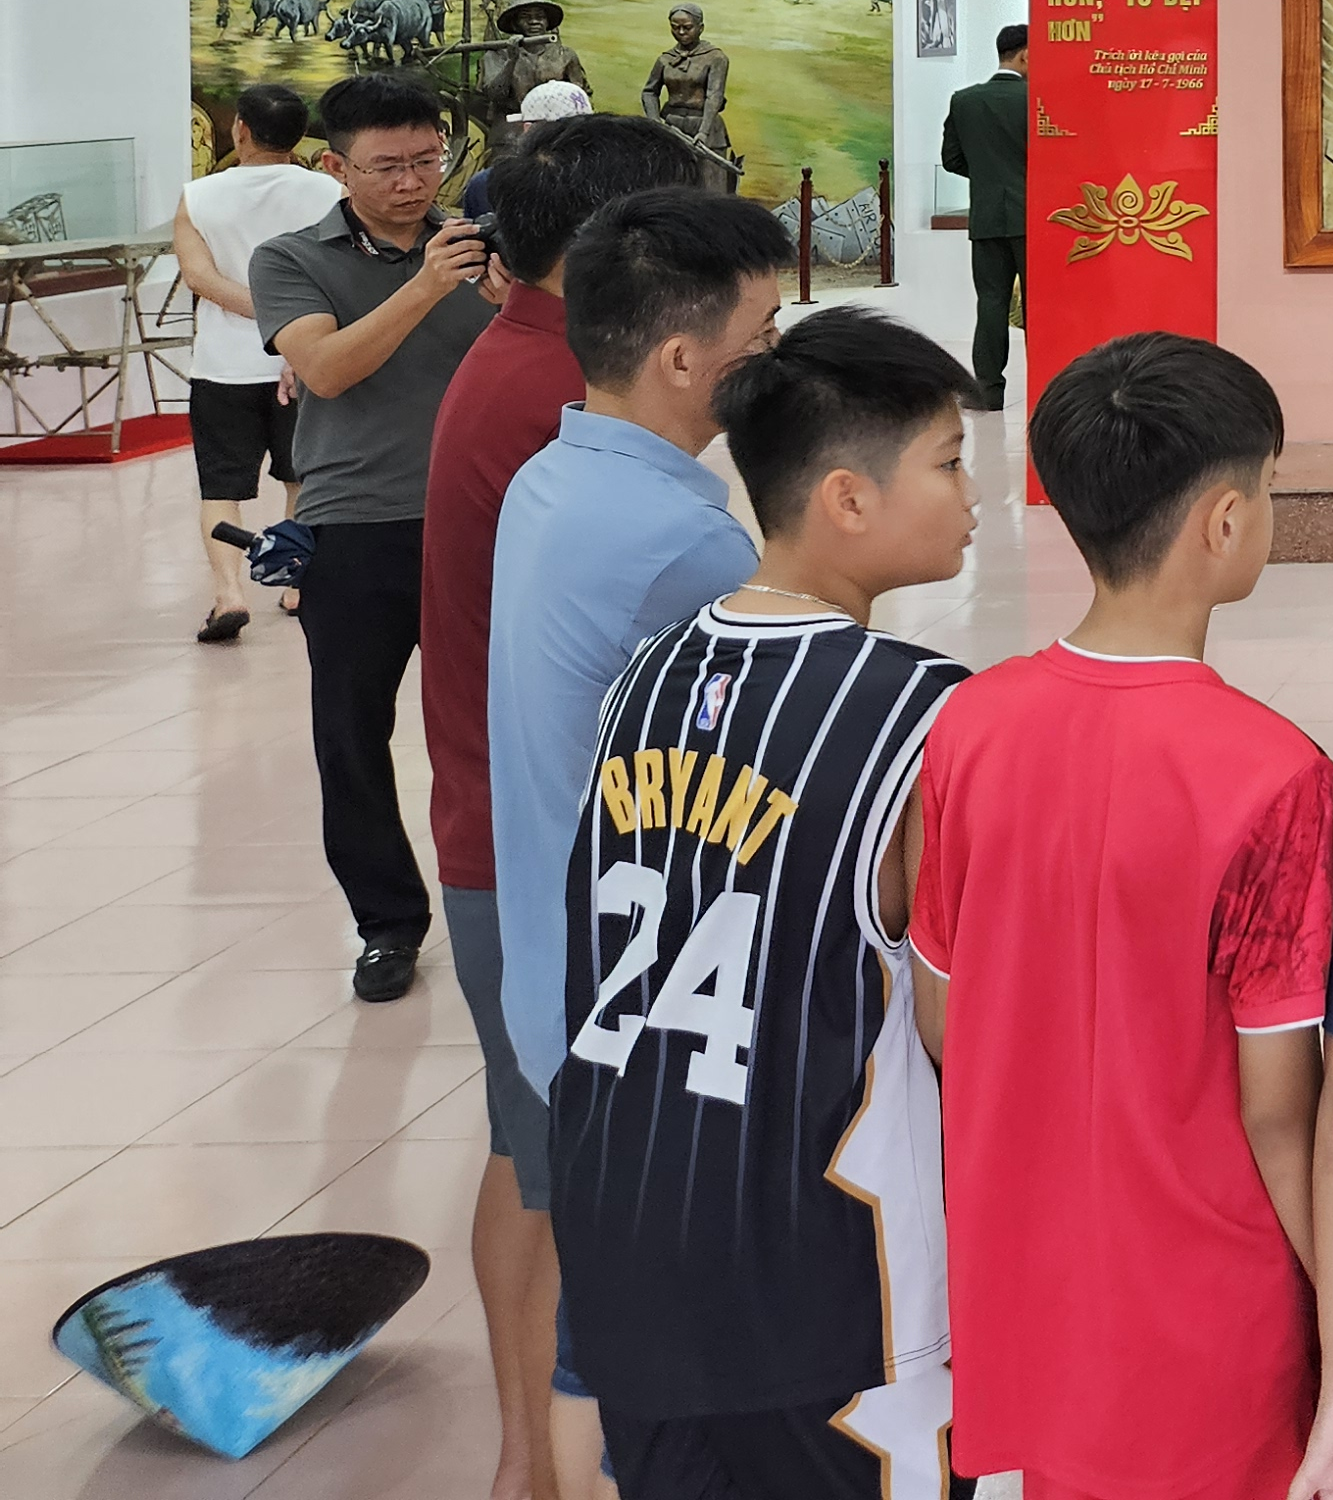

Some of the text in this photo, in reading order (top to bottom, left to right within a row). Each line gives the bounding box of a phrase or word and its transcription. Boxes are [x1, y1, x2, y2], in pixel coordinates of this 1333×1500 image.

[1178, 64, 1208, 75] Minh
[600, 748, 799, 866] BRYANT
[570, 861, 762, 1106] 24
